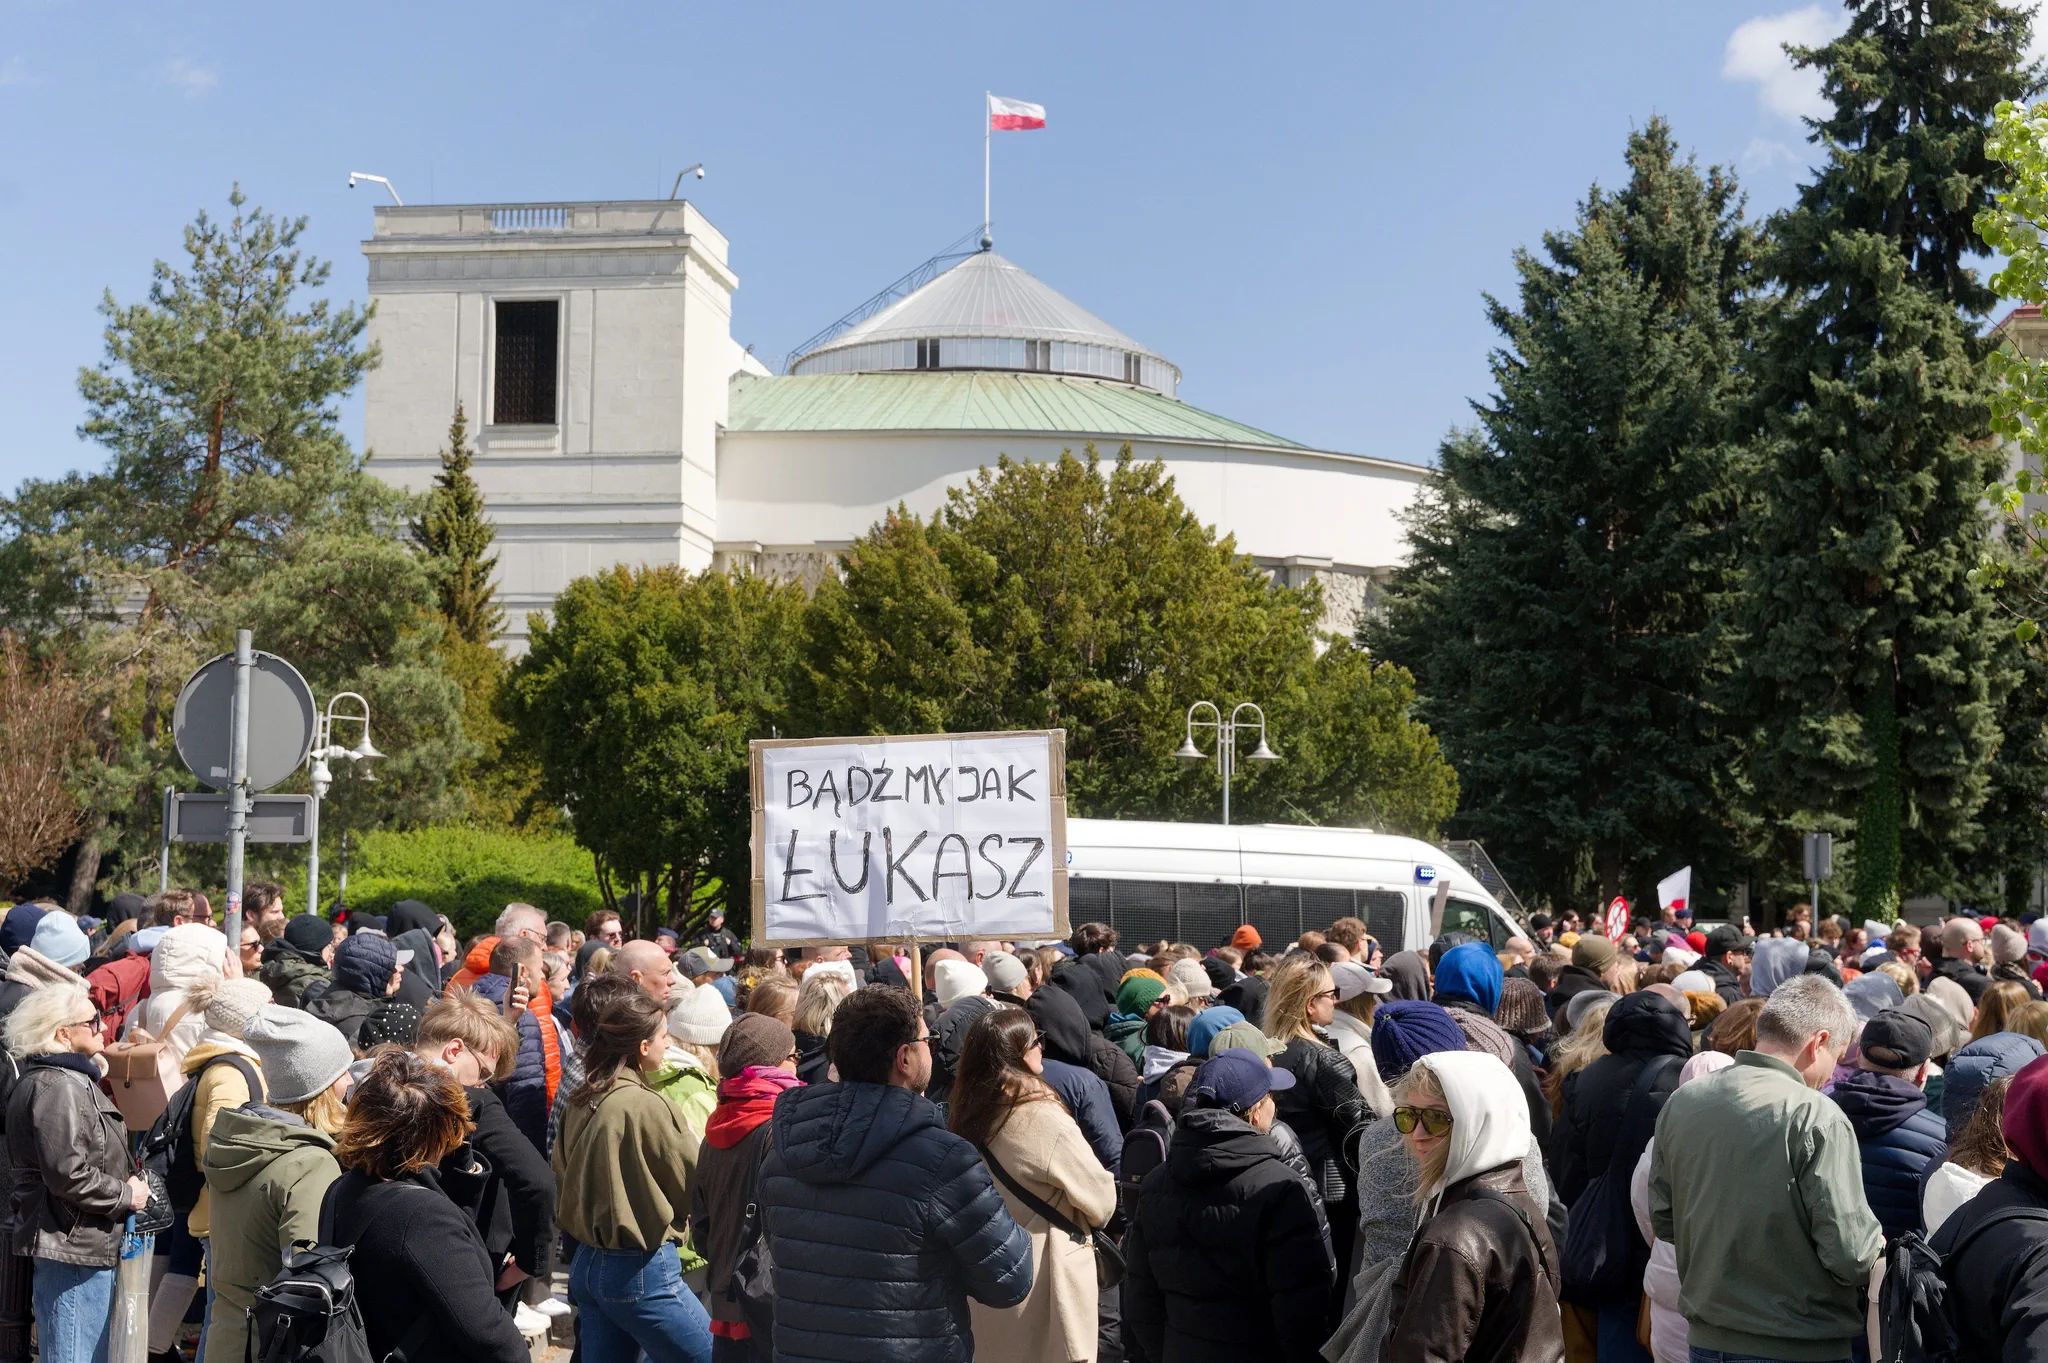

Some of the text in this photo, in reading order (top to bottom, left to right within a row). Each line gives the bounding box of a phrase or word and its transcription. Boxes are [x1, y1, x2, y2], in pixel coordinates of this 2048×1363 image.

[787, 758, 1037, 818] BĄDŹMY JAK
[781, 826, 1045, 905] ŁUKASZ
